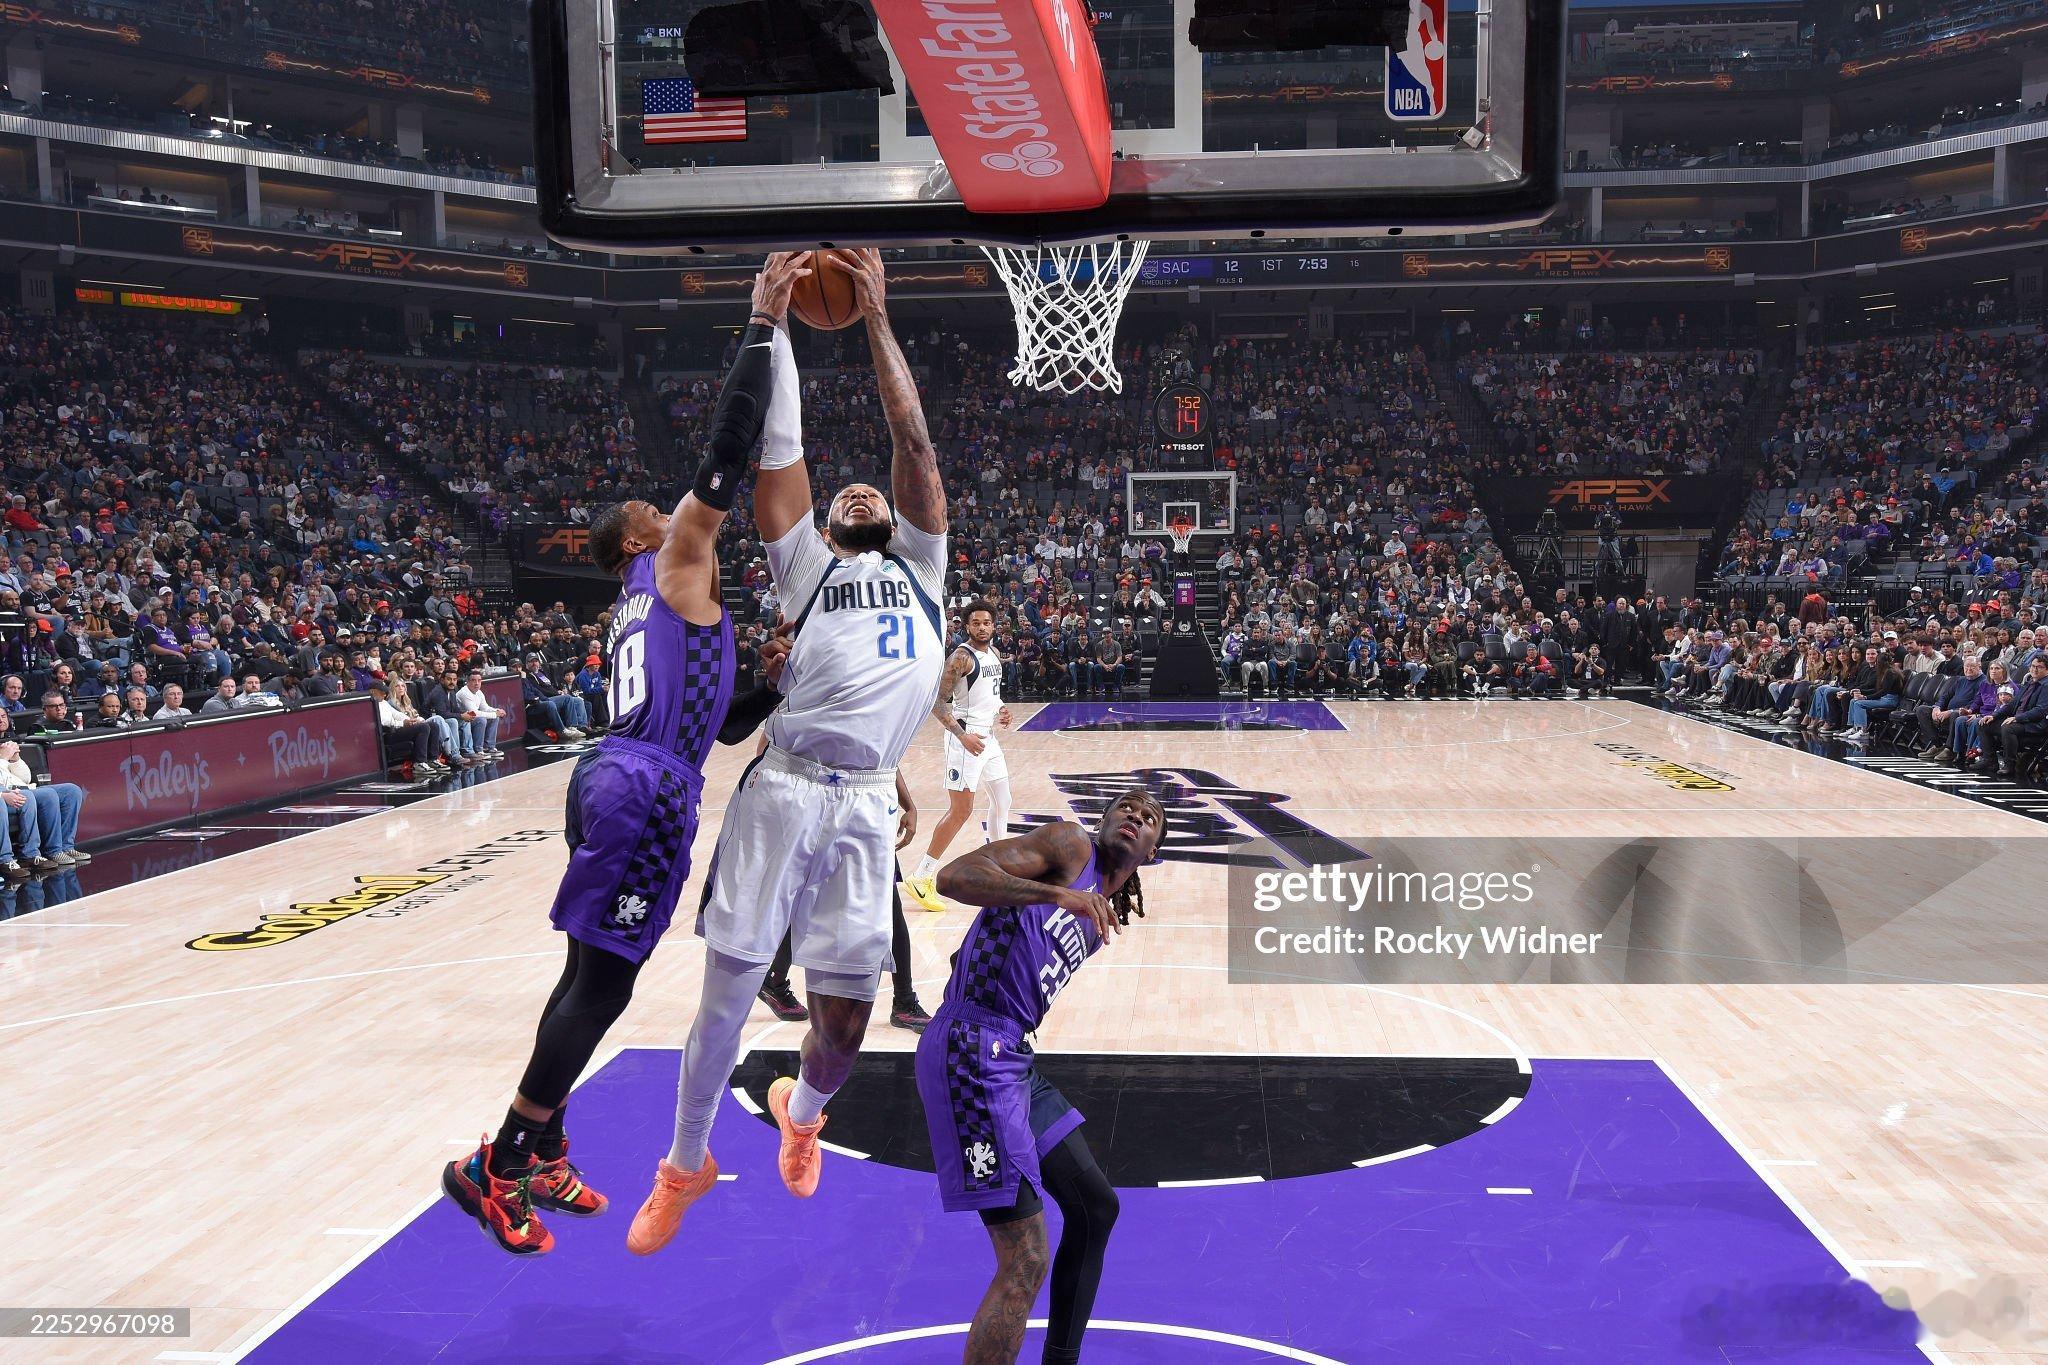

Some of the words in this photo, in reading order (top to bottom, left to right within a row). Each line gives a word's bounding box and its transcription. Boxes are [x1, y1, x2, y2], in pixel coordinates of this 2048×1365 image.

[659, 28, 682, 38] BKN
[1394, 88, 1423, 111] NBA
[314, 243, 417, 272] APEX
[1162, 262, 1190, 274] SAC
[1225, 260, 1240, 272] 12
[1261, 259, 1284, 271] 1ST
[1298, 258, 1329, 270] 7:53
[1519, 249, 1615, 270] APEX
[1173, 396, 1201, 409] 7:52
[1177, 409, 1199, 433] 14
[1172, 443, 1205, 451] TISSOT
[1547, 479, 1671, 503] APEX
[1571, 504, 1585, 512] AT
[1618, 504, 1654, 512] HAWK
[823, 580, 910, 612] DALLAS
[876, 613, 917, 660] 21
[268, 726, 337, 779] Raley's
[119, 749, 211, 811] Raley's
[416, 828, 564, 877] CENTER
